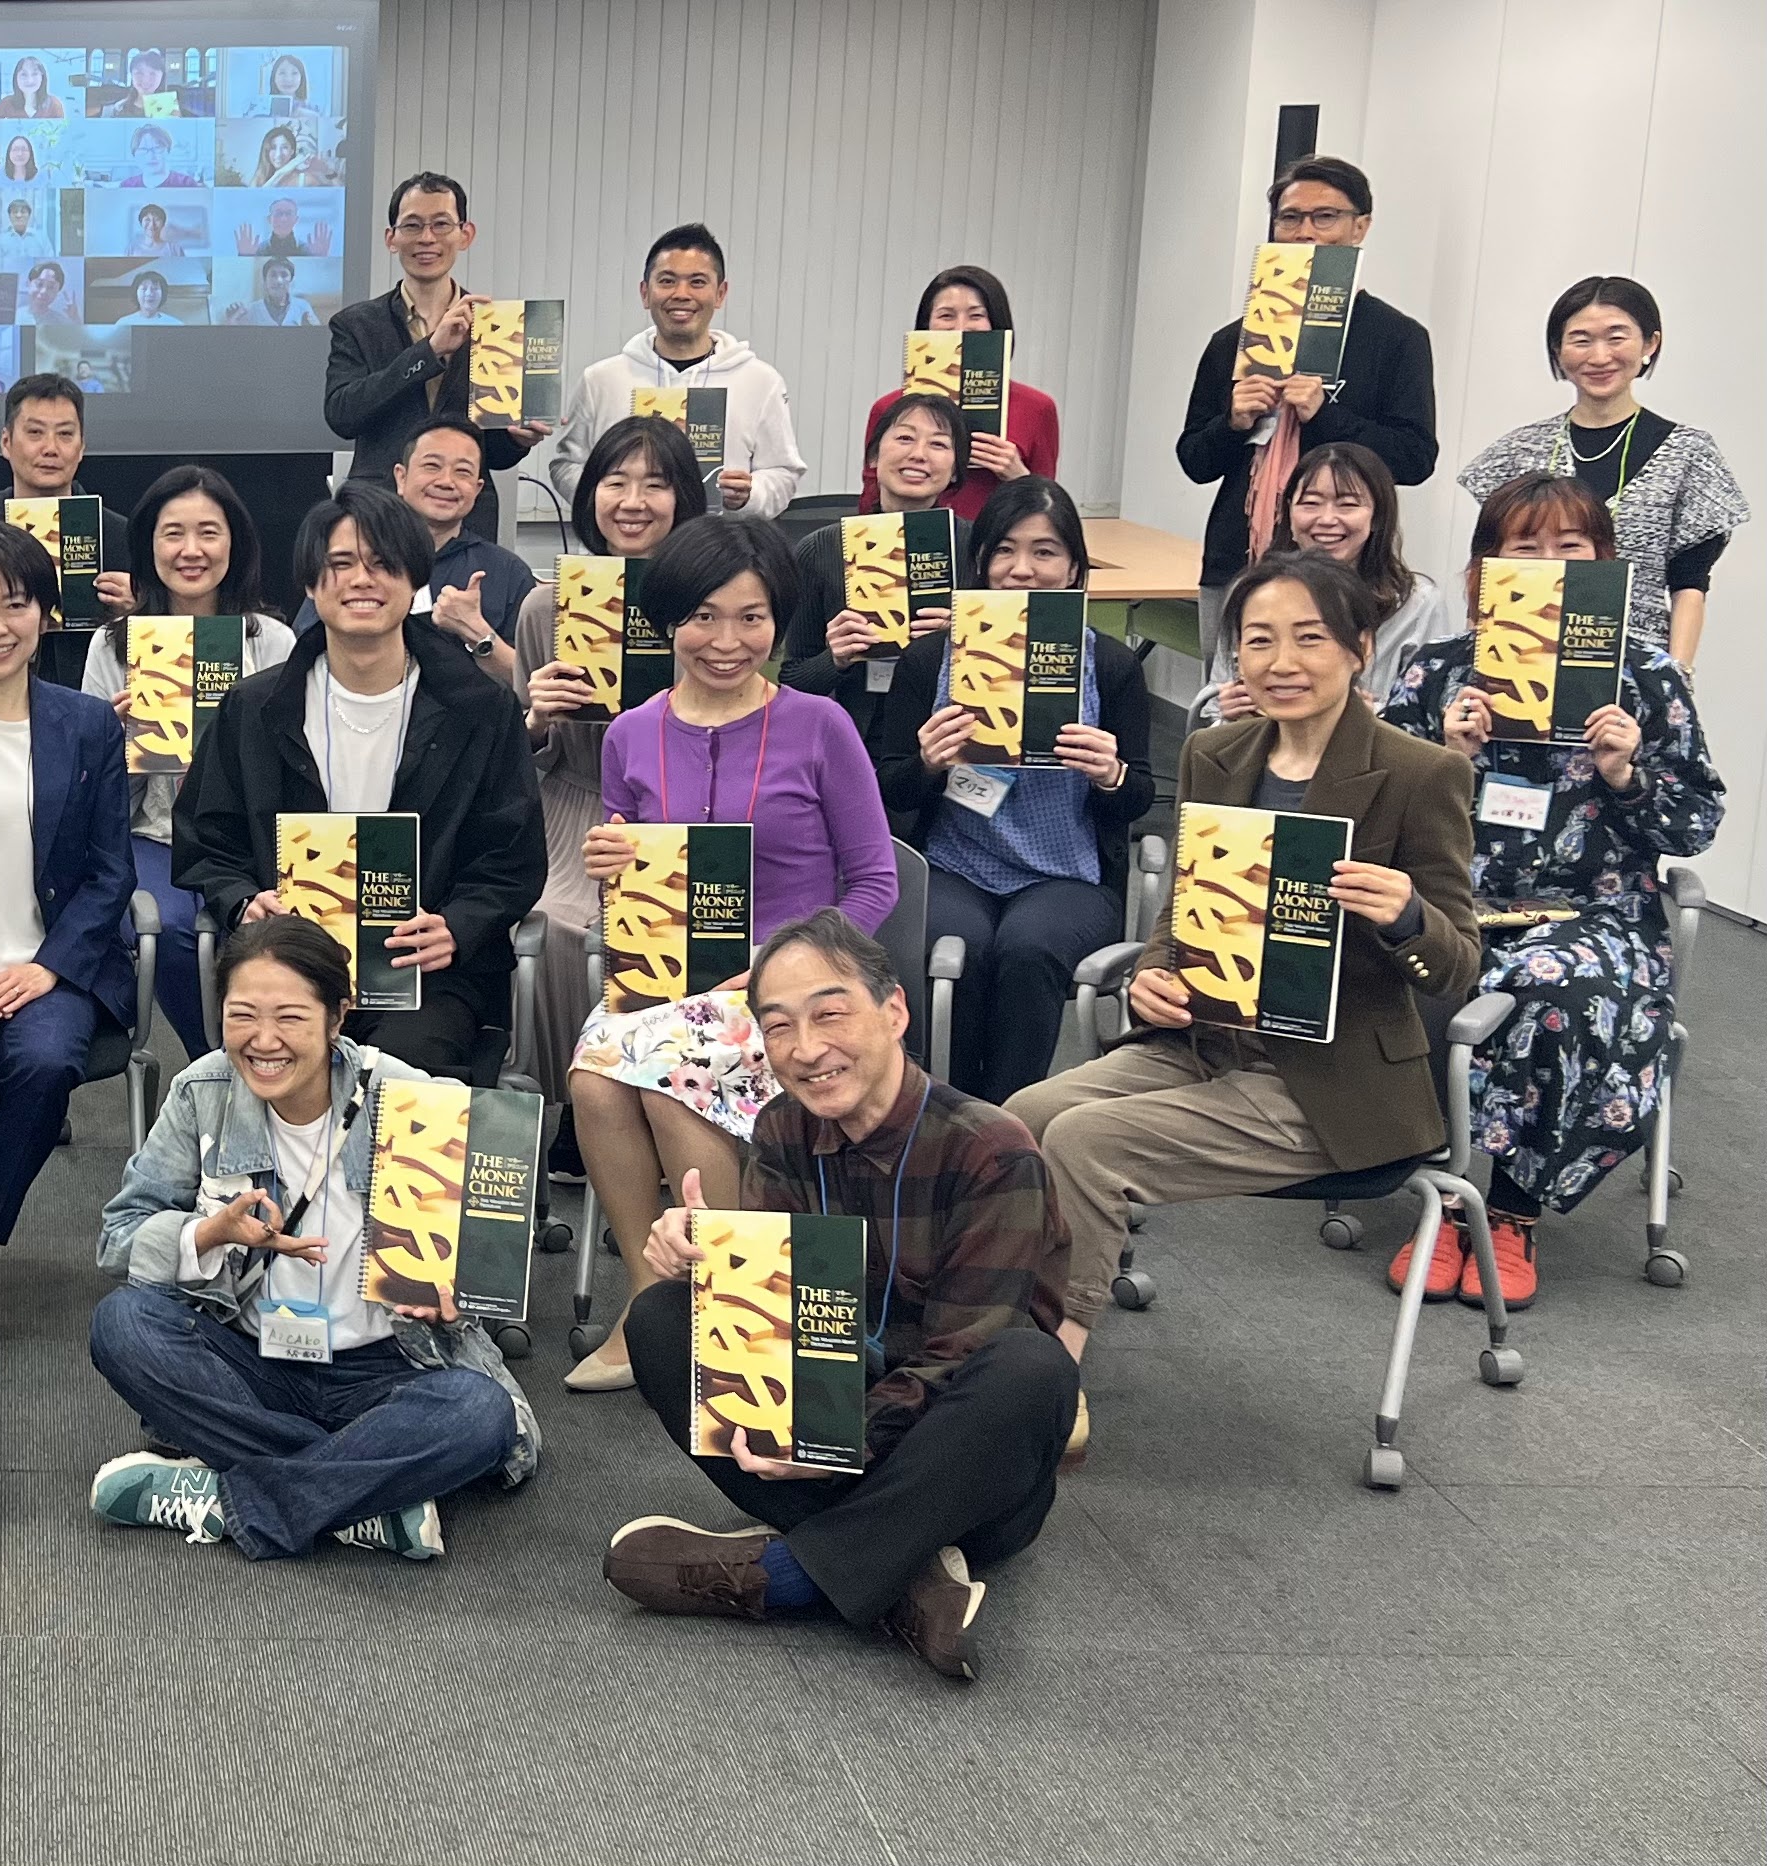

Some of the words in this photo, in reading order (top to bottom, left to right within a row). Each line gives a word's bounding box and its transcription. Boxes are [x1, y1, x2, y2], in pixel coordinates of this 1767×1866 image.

[1311, 285, 1332, 294] THE
[1309, 294, 1346, 304] MONEY
[1307, 303, 1340, 313] CLINIC
[527, 337, 545, 345] THE
[527, 346, 559, 354] MONEY
[526, 354, 556, 362] CLINIC
[964, 369, 984, 379] THE
[963, 379, 999, 387] MONEY
[963, 387, 996, 396] CLINIC
[689, 423, 708, 432] THE
[689, 432, 721, 440] MONEY
[63, 536, 81, 544] THE
[63, 544, 96, 553] MONEY
[63, 552, 94, 561] CLINIC
[908, 553, 931, 562] THE
[910, 561, 948, 571] MONEY
[910, 570, 944, 581] CLINIC
[1565, 613, 1594, 625] THE
[627, 627, 658, 638] CLIN
[1564, 627, 1617, 637] MONEY
[1030, 641, 1057, 653] THE
[1563, 636, 1611, 649] CLINIC
[1030, 654, 1076, 665] MONEY
[196, 661, 219, 672] THE
[1029, 664, 1071, 675] CLINIC
[197, 672, 238, 681] MONEY
[361, 871, 389, 883] THE
[361, 883, 411, 896] MONEY
[692, 882, 722, 894] THE
[1275, 878, 1308, 894] THE
[361, 895, 407, 908] CLINIC
[692, 896, 744, 907] MONEY
[1274, 892, 1333, 911] MONEY
[692, 907, 740, 919] CLINIC
[1272, 905, 1326, 924] CLINIC
[471, 1152, 503, 1168] THE
[470, 1166, 527, 1184] MONEY
[468, 1180, 520, 1199] CLINIC
[797, 1285, 831, 1302] THE
[798, 1302, 857, 1320] MONEY
[798, 1317, 852, 1335] CLINIC
